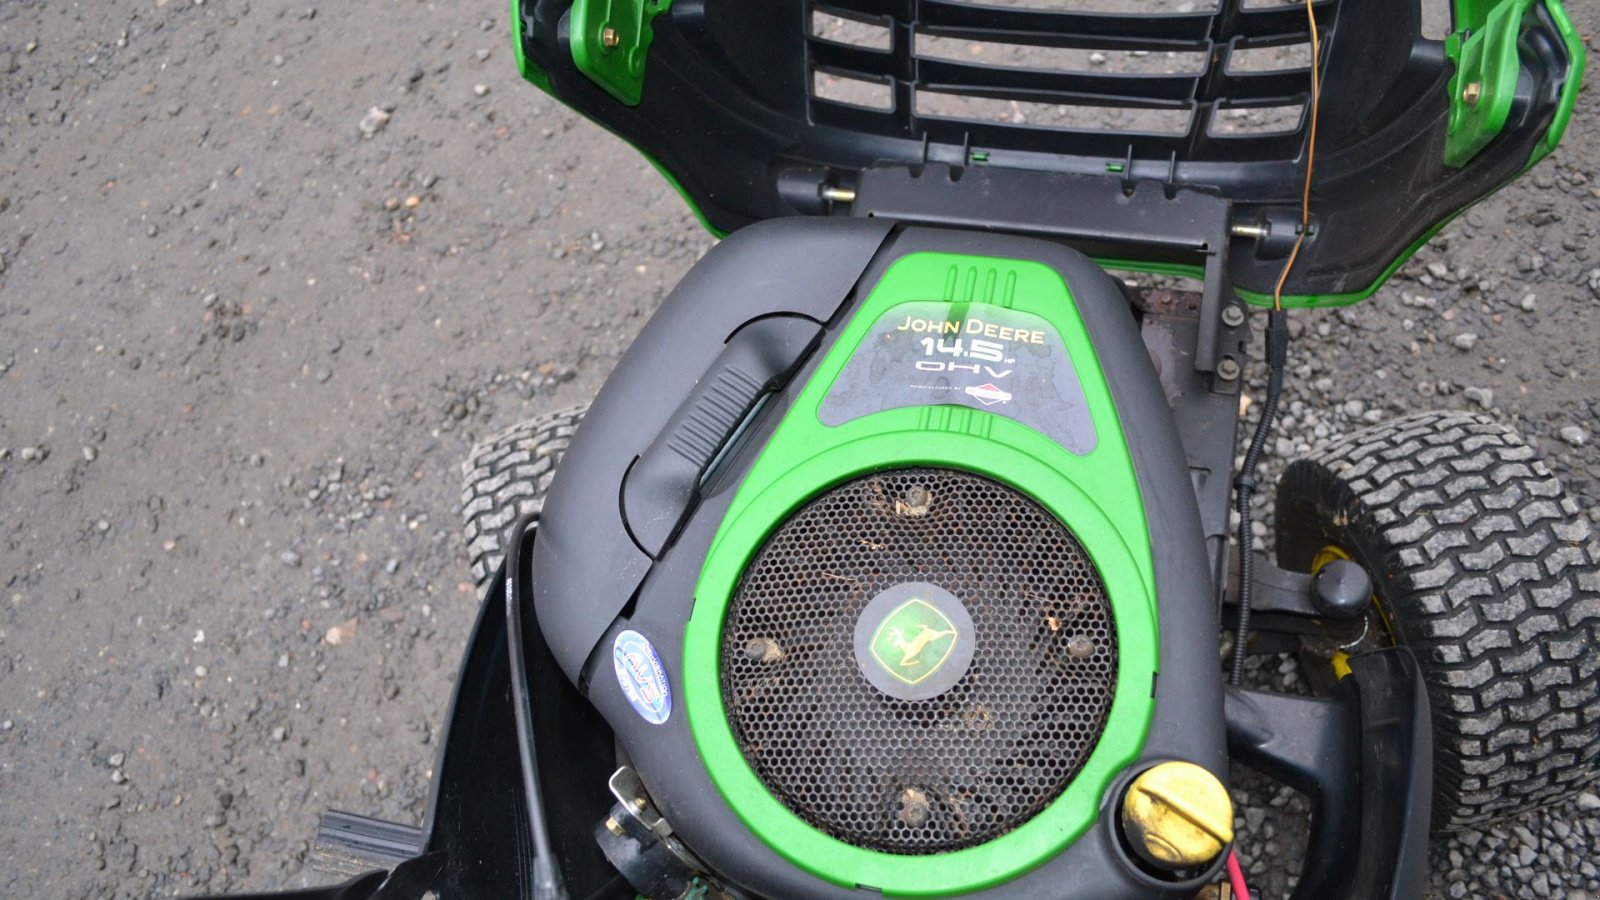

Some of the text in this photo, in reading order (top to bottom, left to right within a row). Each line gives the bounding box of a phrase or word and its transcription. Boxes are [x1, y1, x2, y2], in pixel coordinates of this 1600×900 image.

[920, 337, 1004, 362] 14.5
[915, 360, 1013, 378] OHV
[625, 653, 659, 703] AVS
